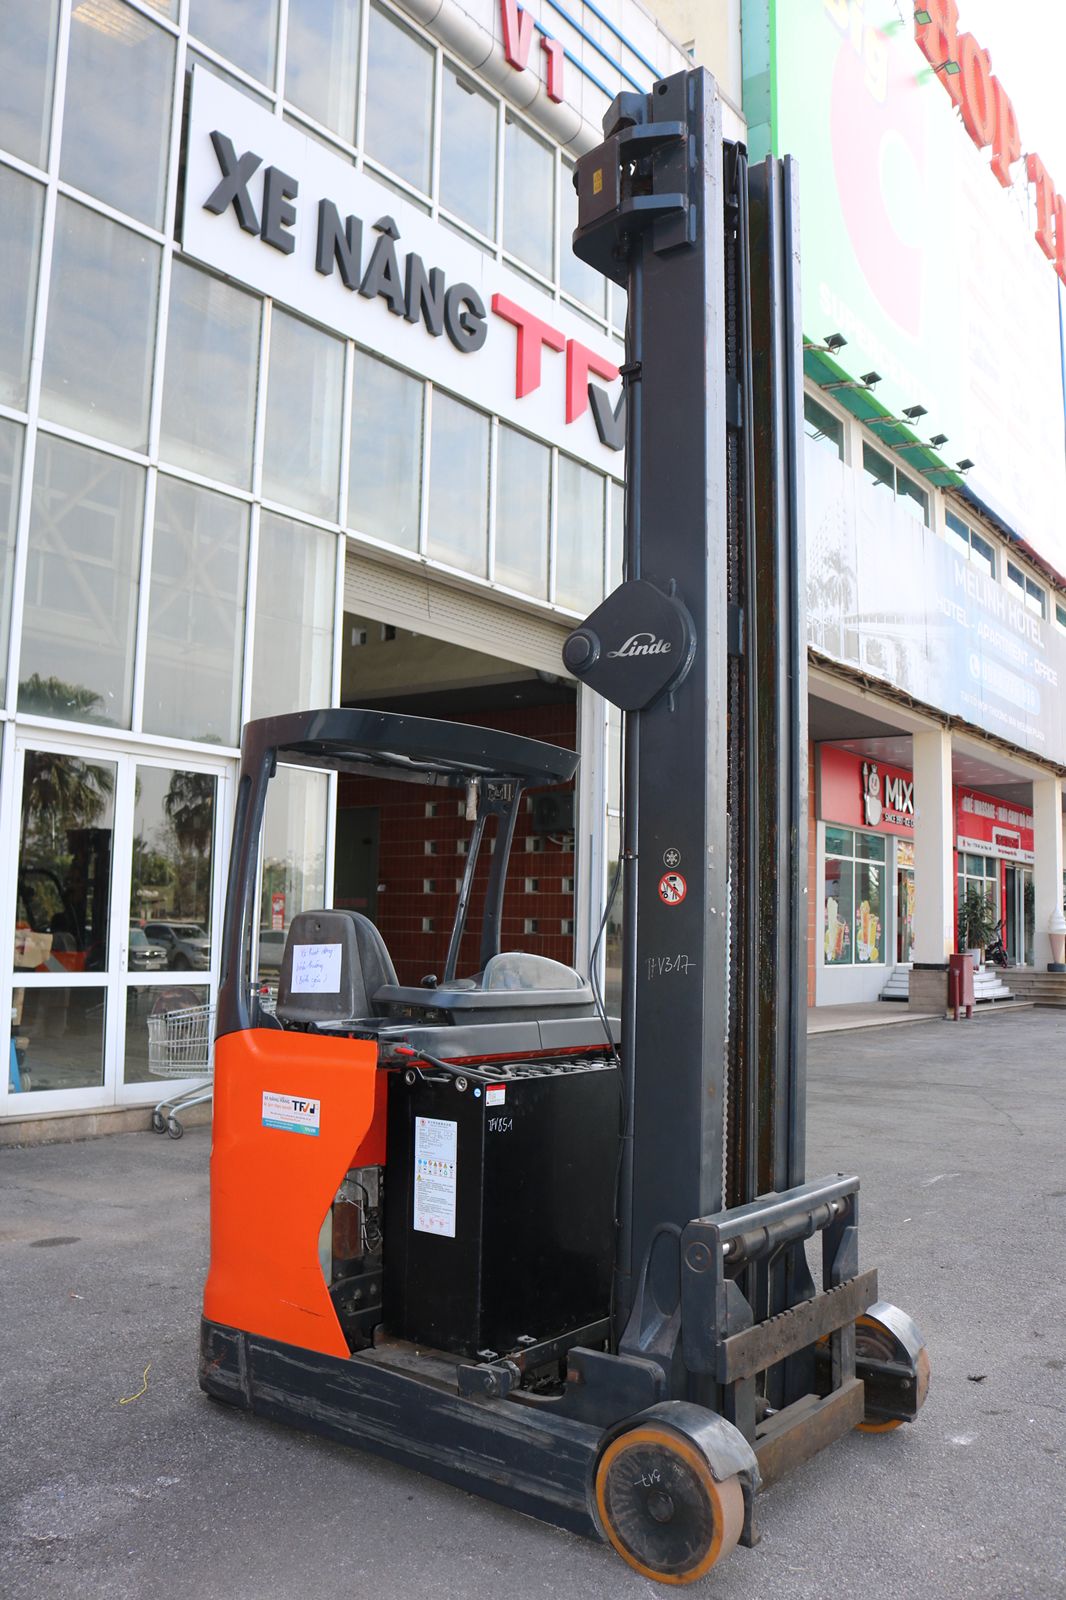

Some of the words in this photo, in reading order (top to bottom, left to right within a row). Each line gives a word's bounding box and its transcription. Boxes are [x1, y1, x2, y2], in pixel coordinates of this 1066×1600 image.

[202, 130, 299, 255] XE
[315, 198, 488, 354] NÂNG
[607, 632, 671, 658] Linde
[1008, 600, 1045, 649] HOTEL
